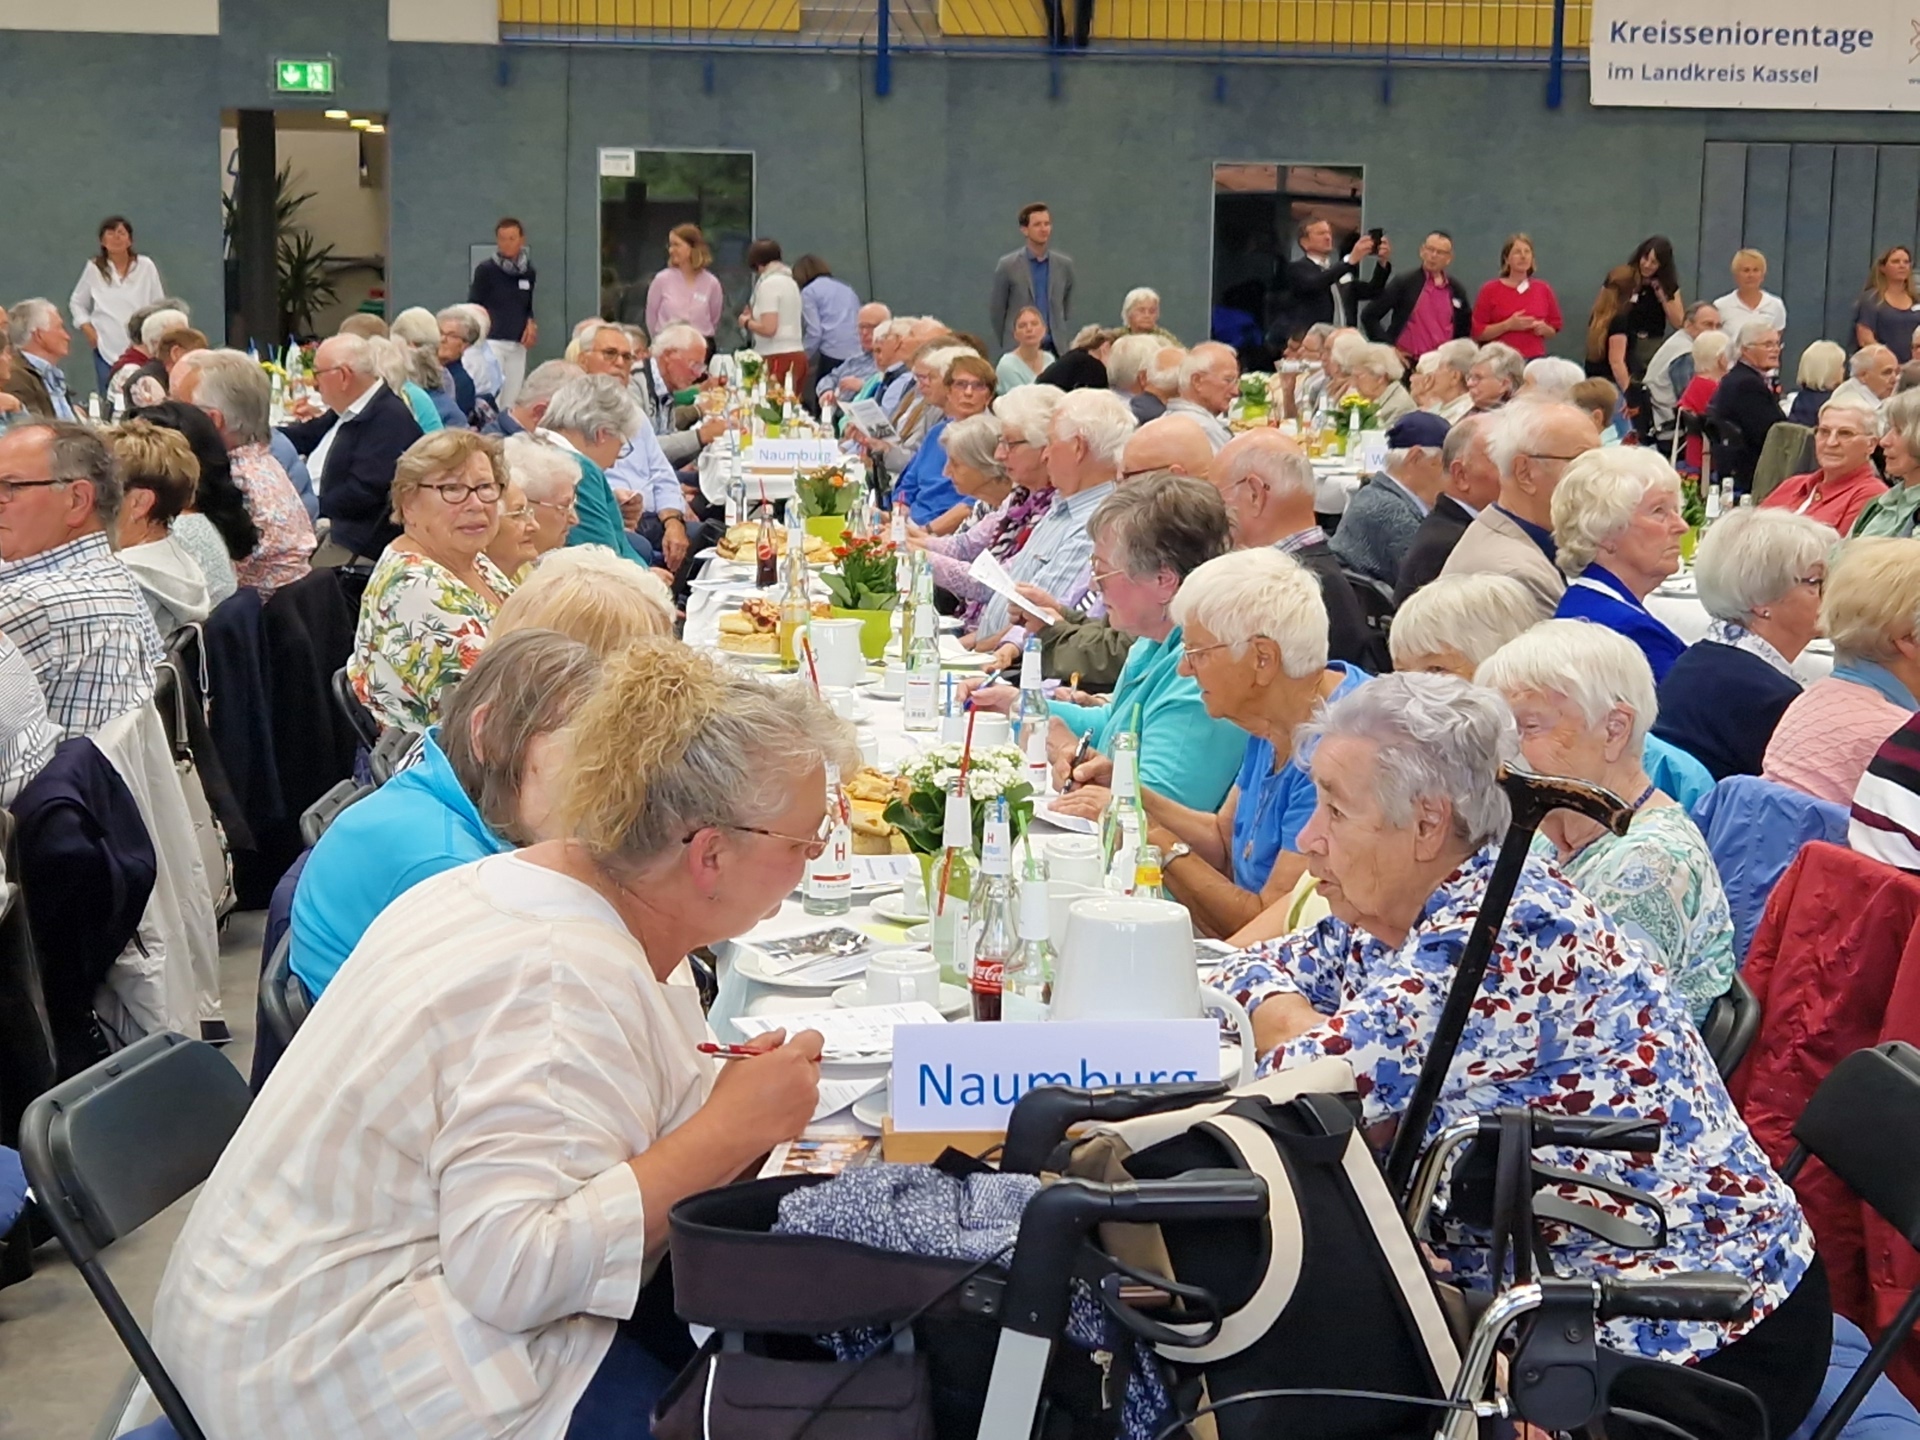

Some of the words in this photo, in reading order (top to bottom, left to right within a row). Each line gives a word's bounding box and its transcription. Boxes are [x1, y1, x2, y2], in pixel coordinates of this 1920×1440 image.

[1610, 19, 1874, 54] Kreisseniorentage
[1607, 62, 1634, 80] im
[1641, 63, 1746, 82] Landkreis
[1752, 65, 1819, 83] Kassel
[759, 449, 831, 464] Naumburg
[918, 1057, 1198, 1107] Naub
